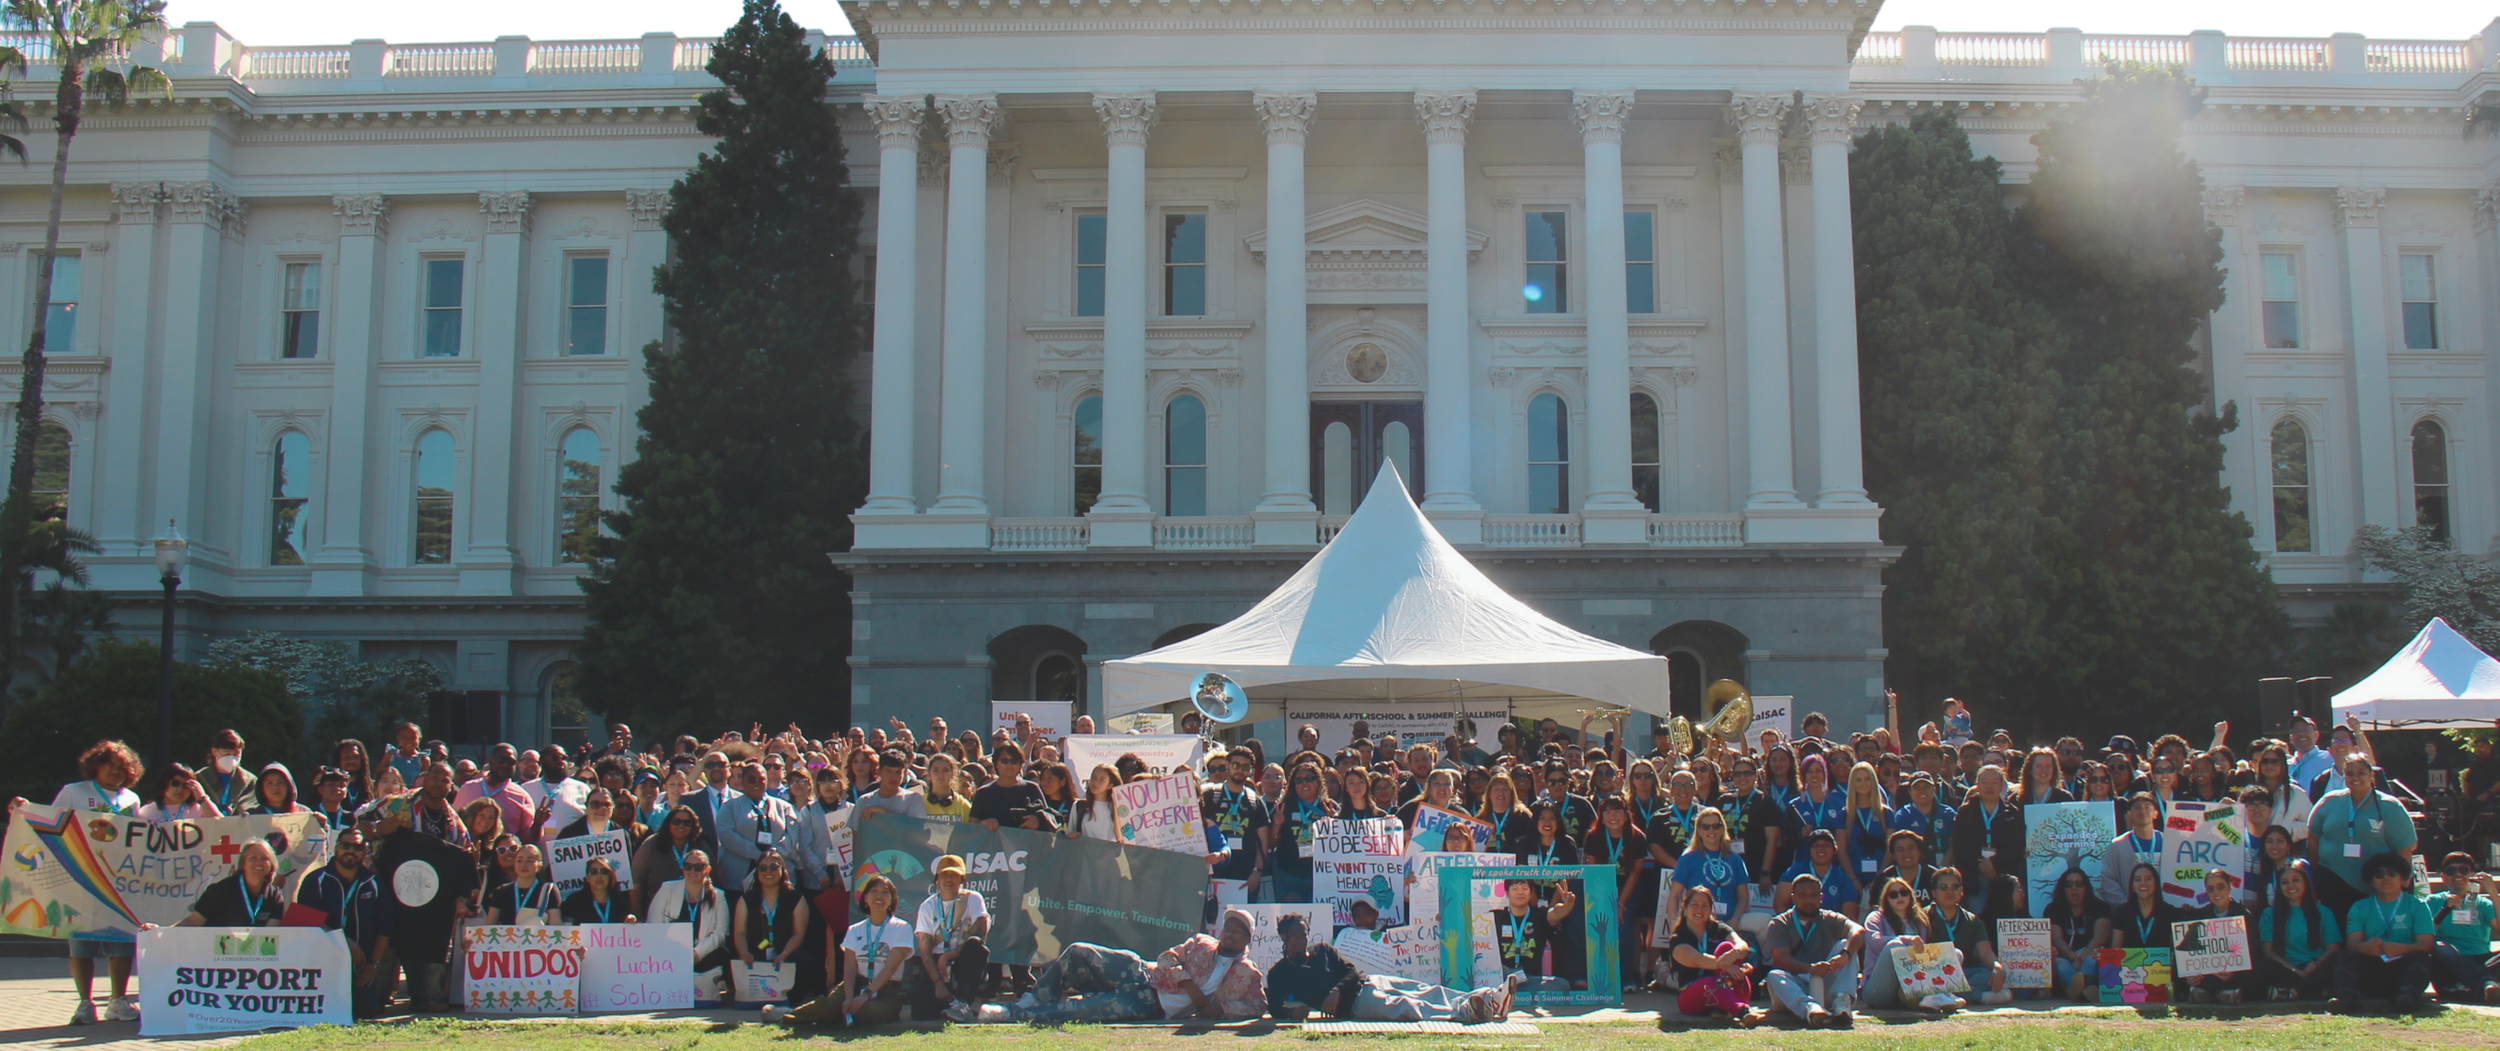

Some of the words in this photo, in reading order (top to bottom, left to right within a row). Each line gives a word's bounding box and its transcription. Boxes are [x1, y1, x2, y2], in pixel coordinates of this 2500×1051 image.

[999, 711, 1034, 721] Uni.
[1290, 712, 1341, 720] CALIFORNIA
[1343, 712, 1406, 720] AFTERSCHOOL
[1408, 712, 1415, 720] &
[1417, 712, 1454, 720] SUMMER
[1751, 720, 1775, 728] ALIFORNIA
[1370, 730, 1397, 740] CalSAC
[1120, 776, 1192, 810] YOUTH
[1130, 805, 1200, 832] DESERVE
[1315, 820, 1339, 835] WE
[1343, 818, 1384, 836] WANT
[2168, 818, 2196, 832] HOPE
[125, 821, 204, 853] FUND
[2048, 830, 2098, 841] Expanded
[2217, 821, 2240, 845] UNITE
[555, 844, 584, 864] SAN
[586, 838, 622, 858] DIEGO
[1315, 836, 1340, 854] TO
[1341, 836, 1362, 854] BE
[1362, 834, 1400, 855] SEEN
[2051, 841, 2096, 850] Learning
[2176, 840, 2230, 867] ARC
[117, 853, 202, 880] AFTER
[930, 850, 1029, 876] ClSAC
[1315, 861, 1333, 874] WE
[1369, 863, 1385, 874] TO
[1387, 862, 1404, 875] BE
[1419, 854, 1477, 876] AFTER
[1472, 868, 1486, 877] We
[1488, 868, 1514, 878] spoke
[1516, 867, 1540, 877] truth
[1542, 868, 1551, 876] to
[1553, 867, 1585, 877] power!
[2175, 868, 2203, 880] CARE
[116, 876, 194, 898] SCHOOL
[557, 877, 587, 891] ORAN
[1027, 896, 1065, 910] Unite.
[1067, 900, 1129, 920] Empower.
[1132, 911, 1194, 932] Transform.
[2207, 918, 2244, 937] AFTER
[590, 927, 642, 949] Nadie
[2007, 938, 2029, 947] MORE
[1392, 944, 1411, 956] The
[467, 949, 579, 980] UNIDOS
[617, 955, 674, 974] Lucha
[1395, 956, 1412, 967] And
[2010, 961, 2044, 970] STRONGER
[2185, 957, 2210, 972] FOR
[2210, 954, 2243, 969] GOOD
[176, 966, 322, 991] SUPPORT
[168, 988, 222, 1009] OUR
[224, 994, 325, 1014] YOUTH!
[609, 983, 662, 1006] Solo
[1542, 994, 1575, 1002] Summer
[1576, 994, 1615, 1003] Challenge
